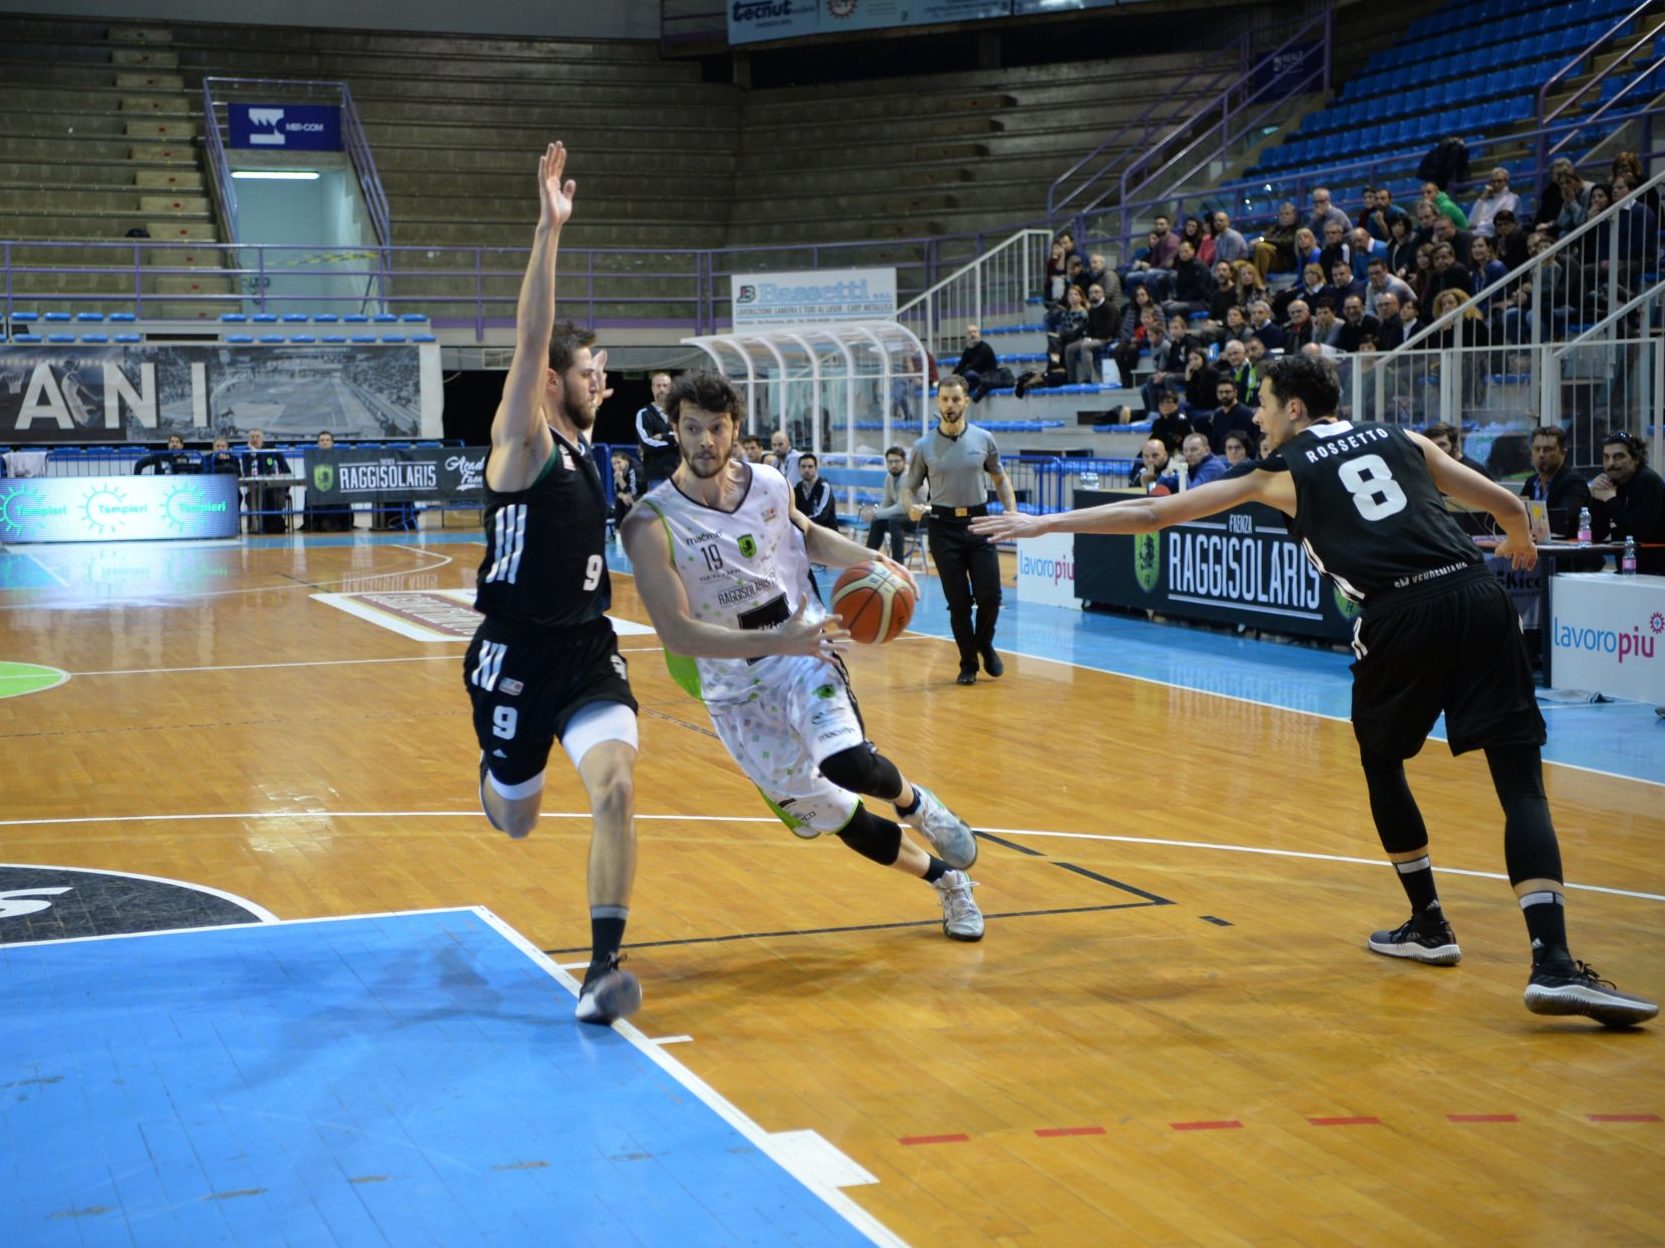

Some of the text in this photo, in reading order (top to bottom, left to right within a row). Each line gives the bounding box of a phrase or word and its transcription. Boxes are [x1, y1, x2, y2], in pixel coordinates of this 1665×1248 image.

[1306, 427, 1389, 463] ROSSETTO
[339, 465, 437, 489] RAGGISOLARIS
[1338, 454, 1408, 522] 8
[1229, 514, 1252, 535] FAENZA
[583, 554, 603, 592] 9
[701, 543, 723, 572] 19
[1168, 531, 1321, 610] RAGGISOLARIS
[492, 705, 518, 740] 9
